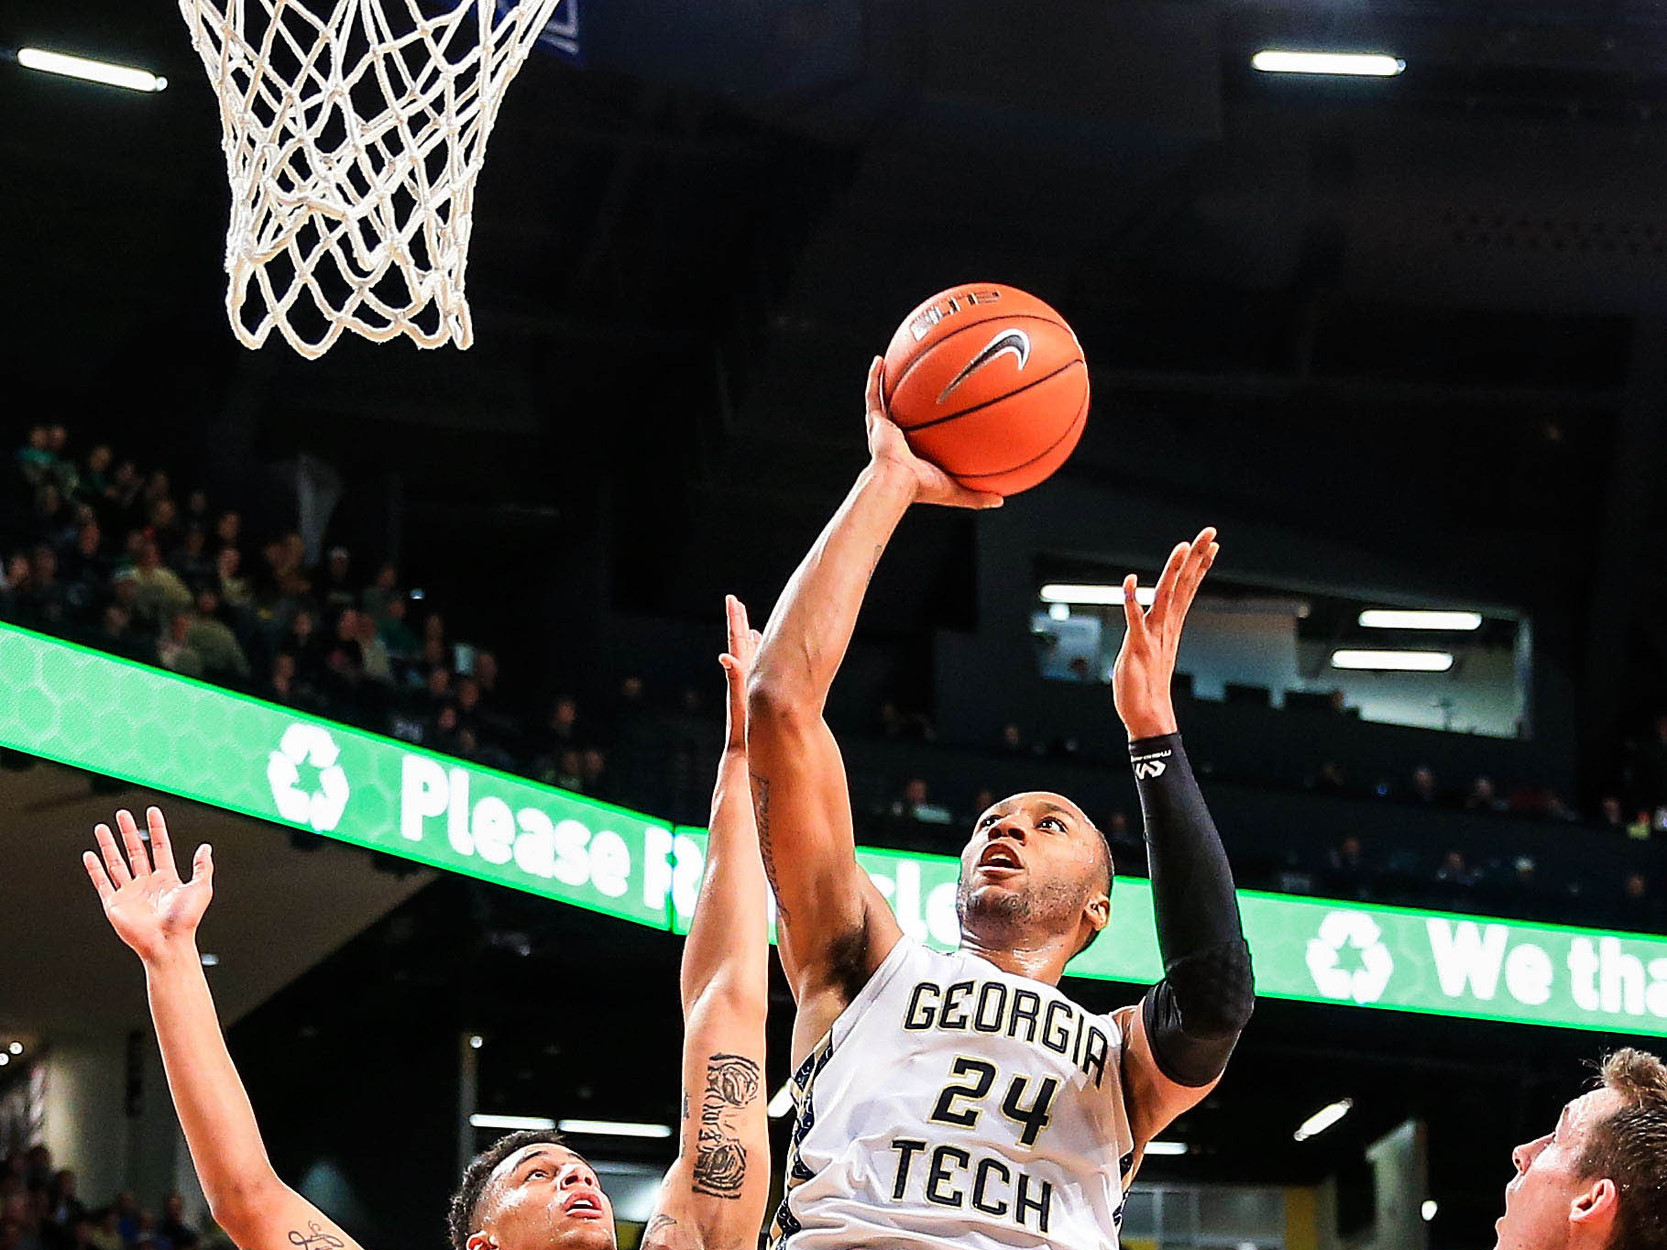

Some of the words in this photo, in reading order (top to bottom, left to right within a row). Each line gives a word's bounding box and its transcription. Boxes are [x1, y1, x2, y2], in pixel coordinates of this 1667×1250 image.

[401, 754, 631, 898] Please
[1425, 917, 1554, 1006] We
[903, 980, 1109, 1091] GEORGIA
[928, 1054, 1062, 1150] 24
[890, 1137, 1053, 1235] TECH
